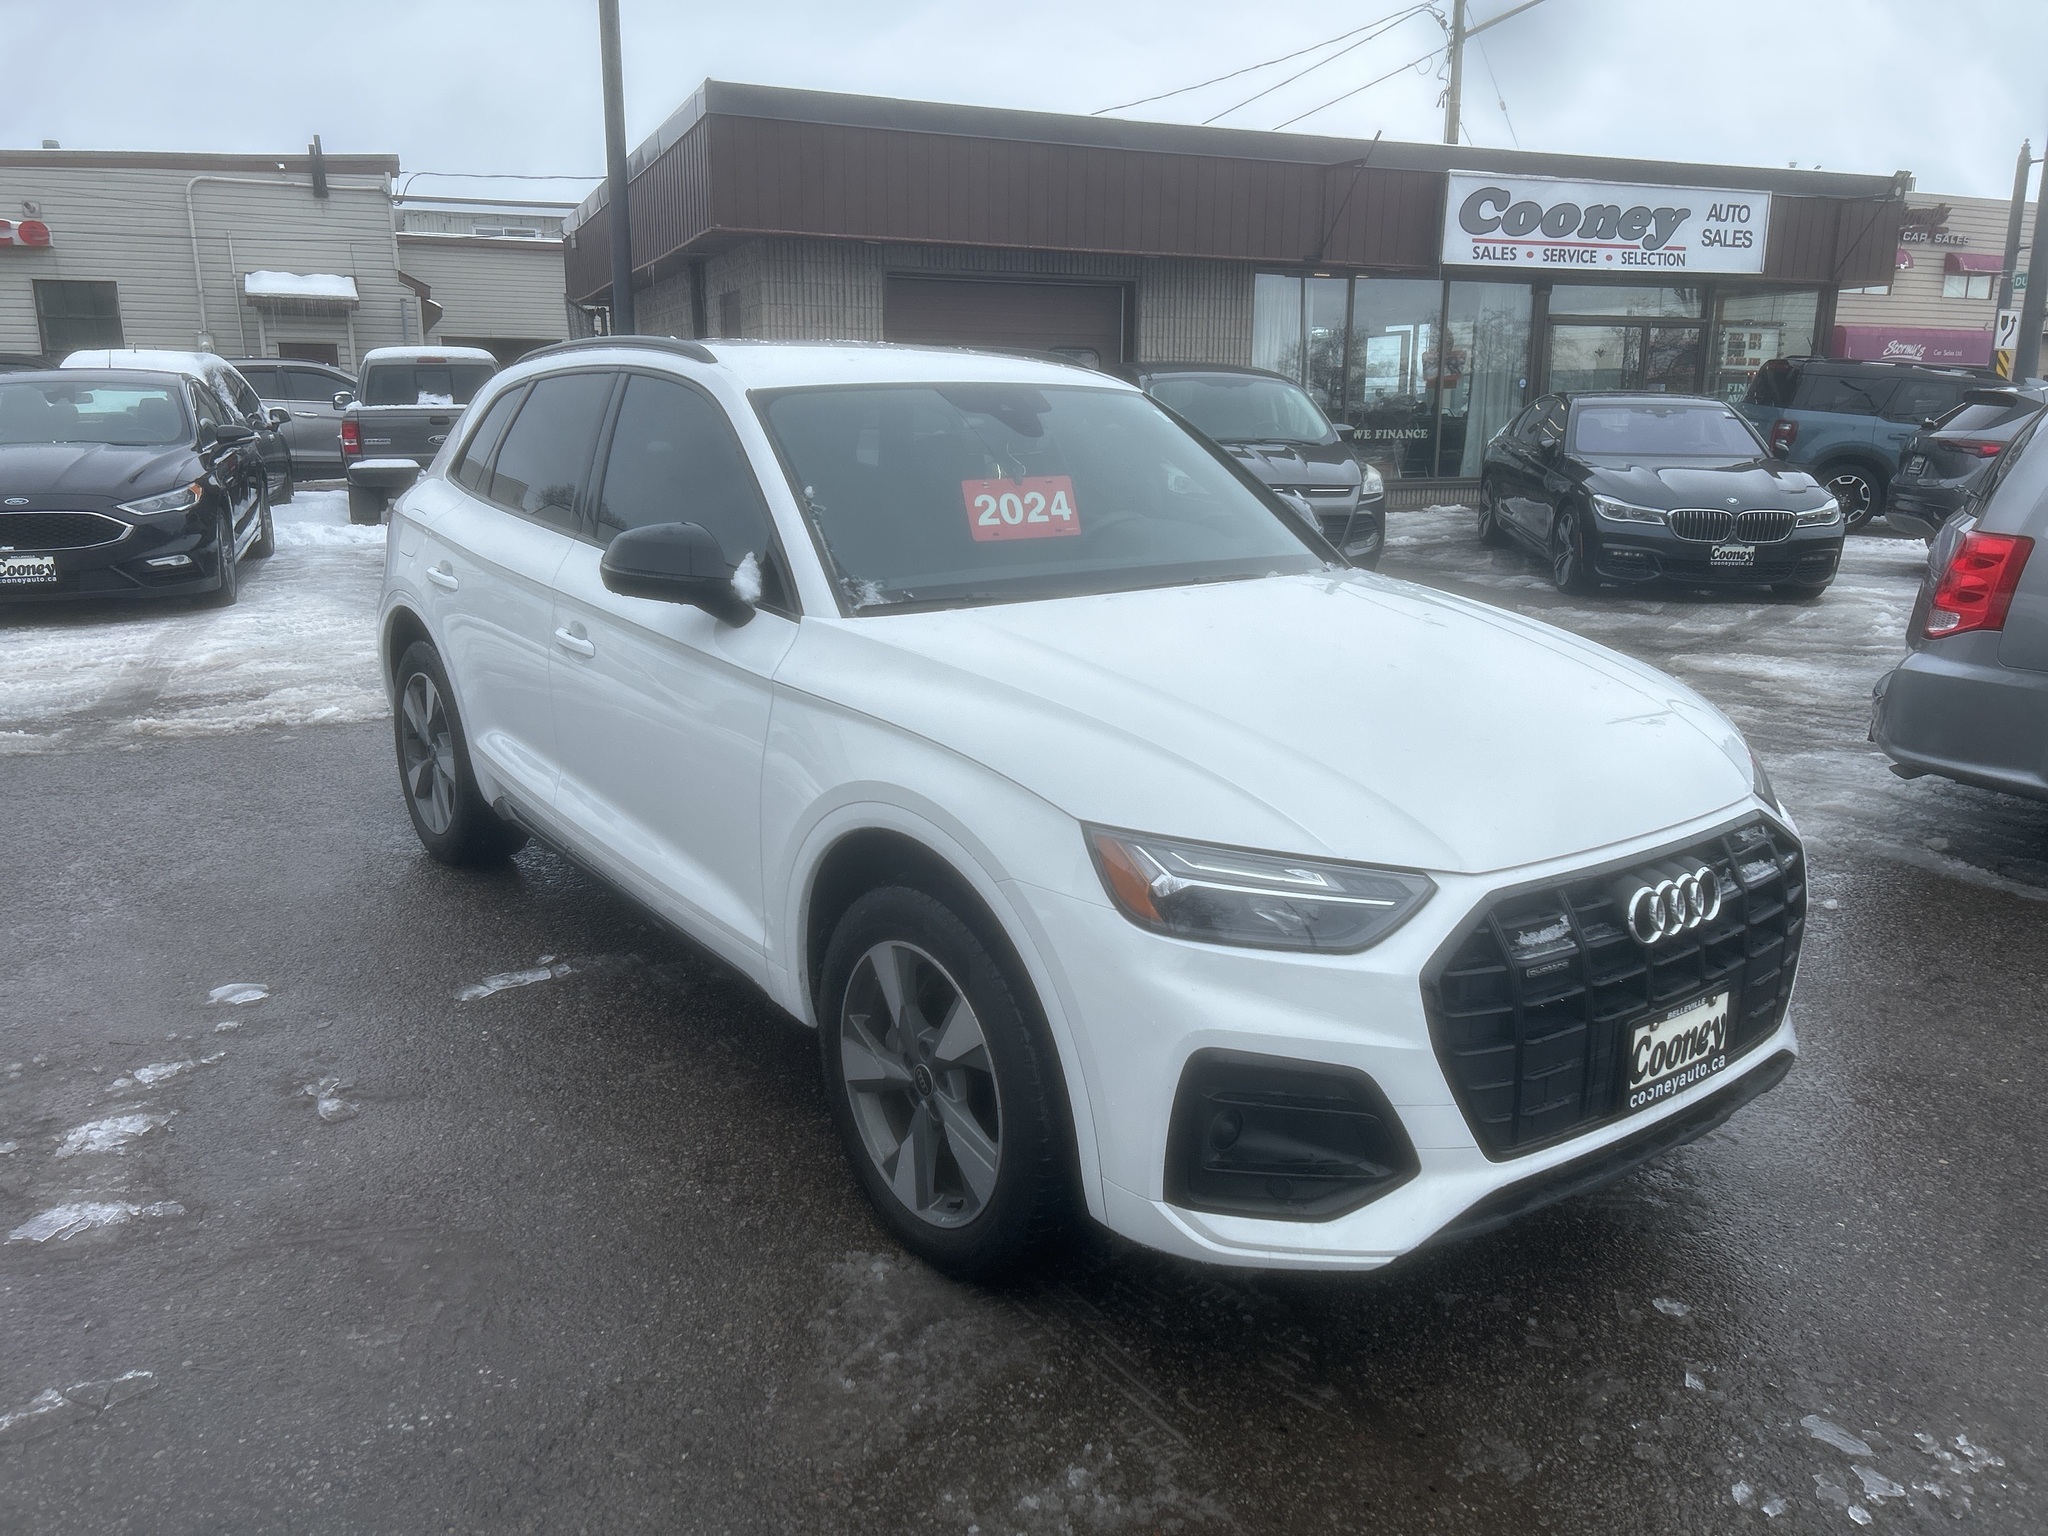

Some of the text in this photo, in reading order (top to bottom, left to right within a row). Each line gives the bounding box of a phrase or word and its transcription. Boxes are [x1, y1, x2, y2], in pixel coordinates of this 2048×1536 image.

[1459, 187, 1691, 250] Cooney
[1706, 203, 1750, 223] AUTO
[1701, 228, 1753, 249] SALES
[1902, 231, 1970, 245] CAR SALES
[1472, 246, 1686, 267] SALES SERVICE SELECTION
[1353, 429, 1428, 440] WE FINANCE
[974, 490, 1072, 526] 2024
[1711, 547, 1754, 561] Cooney
[1666, 997, 1706, 1020] BELLEVILLE
[1629, 1013, 1726, 1086] Cooney
[1630, 1054, 1726, 1109] cooneyauto.ca
